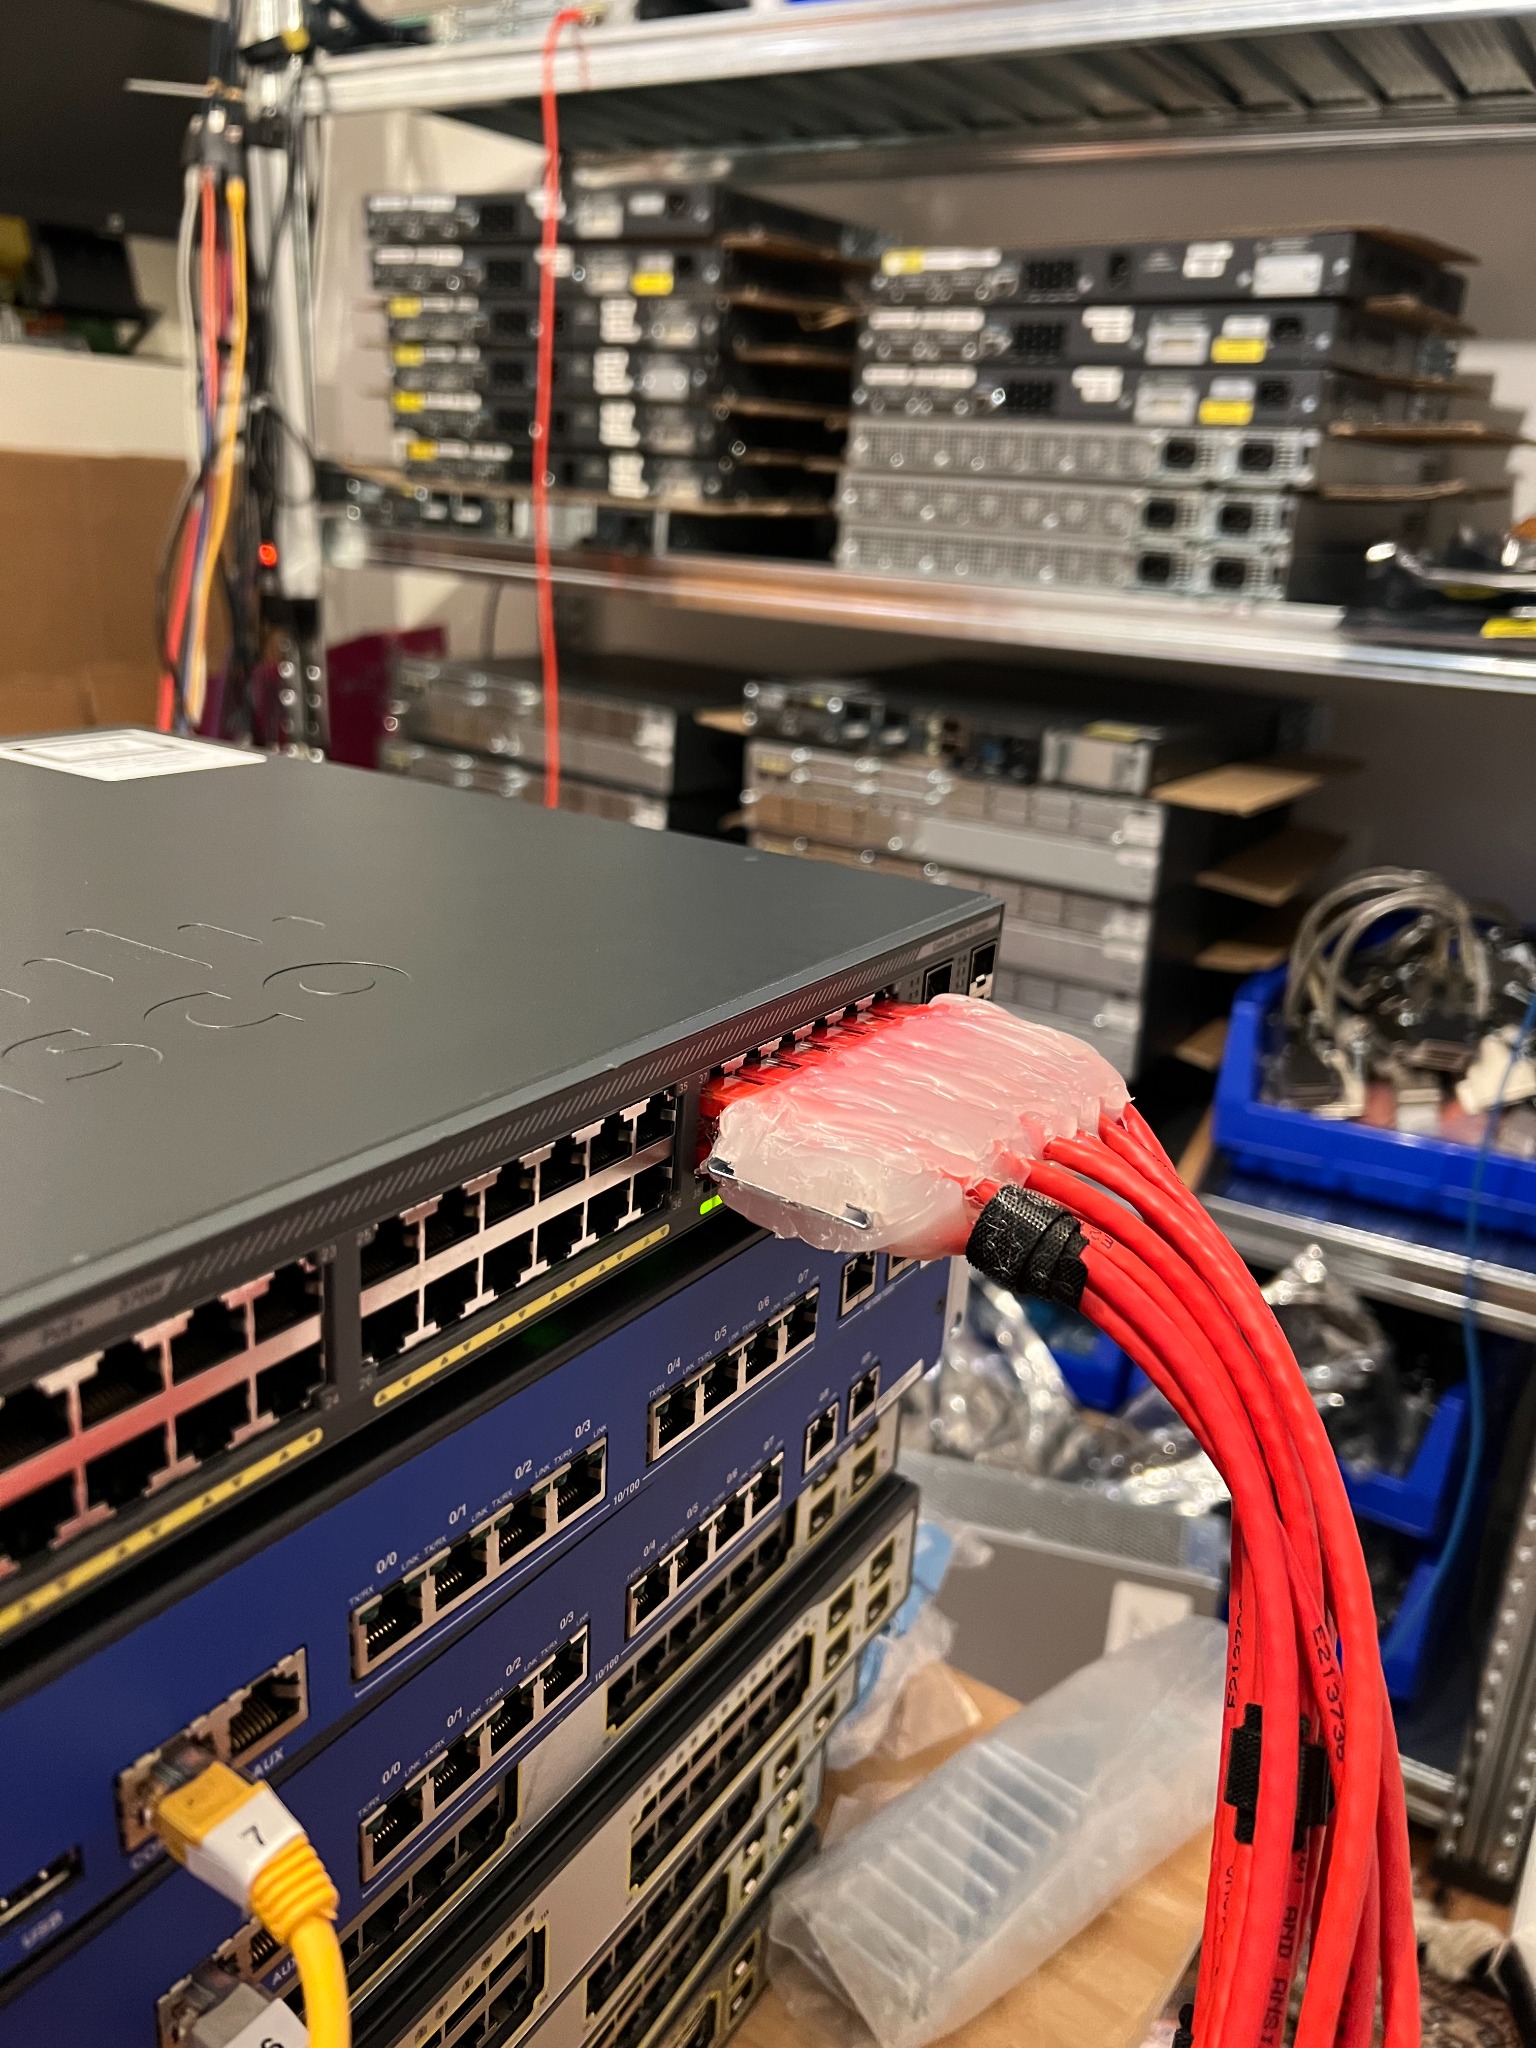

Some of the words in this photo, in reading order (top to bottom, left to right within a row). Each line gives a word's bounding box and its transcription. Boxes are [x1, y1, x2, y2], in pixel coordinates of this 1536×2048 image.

[679, 1081, 688, 1093] 35
[699, 1072, 708, 1085] 37
[758, 1296, 770, 1312] 0/6
[714, 1325, 727, 1342] 0/5
[667, 1356, 681, 1375] 0/4
[682, 1363, 695, 1376] LINK
[698, 1350, 713, 1365] TX/RX
[649, 1381, 666, 1399] TX/RX
[575, 1419, 591, 1438] 0/3
[593, 1424, 608, 1438] LINK
[514, 1459, 532, 1480] 0/2
[535, 1462, 550, 1479] LINK
[553, 1447, 573, 1465] TX/RX
[613, 1478, 640, 1506] 10/100
[449, 1503, 467, 1525] 0/1
[471, 1506, 488, 1523] LINK
[491, 1488, 513, 1508] TX/RX
[401, 1555, 419, 1571] LINK
[424, 1535, 447, 1555] TX/RX
[643, 1539, 656, 1557] 0/4
[376, 1551, 398, 1575] 0/0
[559, 1611, 574, 1630] 0/3
[575, 1612, 590, 1627] LINK
[505, 1656, 522, 1677] 0/2
[523, 1655, 538, 1673] LINK
[594, 1654, 620, 1683] 10/100
[447, 1706, 463, 1728] 0/1
[466, 1706, 483, 1723] LINK
[254, 1745, 285, 1778] AUX
[404, 1758, 421, 1778] LINK
[424, 1736, 447, 1759] TX/RX
[382, 1761, 401, 1785] 0/0
[240, 1824, 265, 1847] 7
[1278, 1907, 1298, 1959] AND
